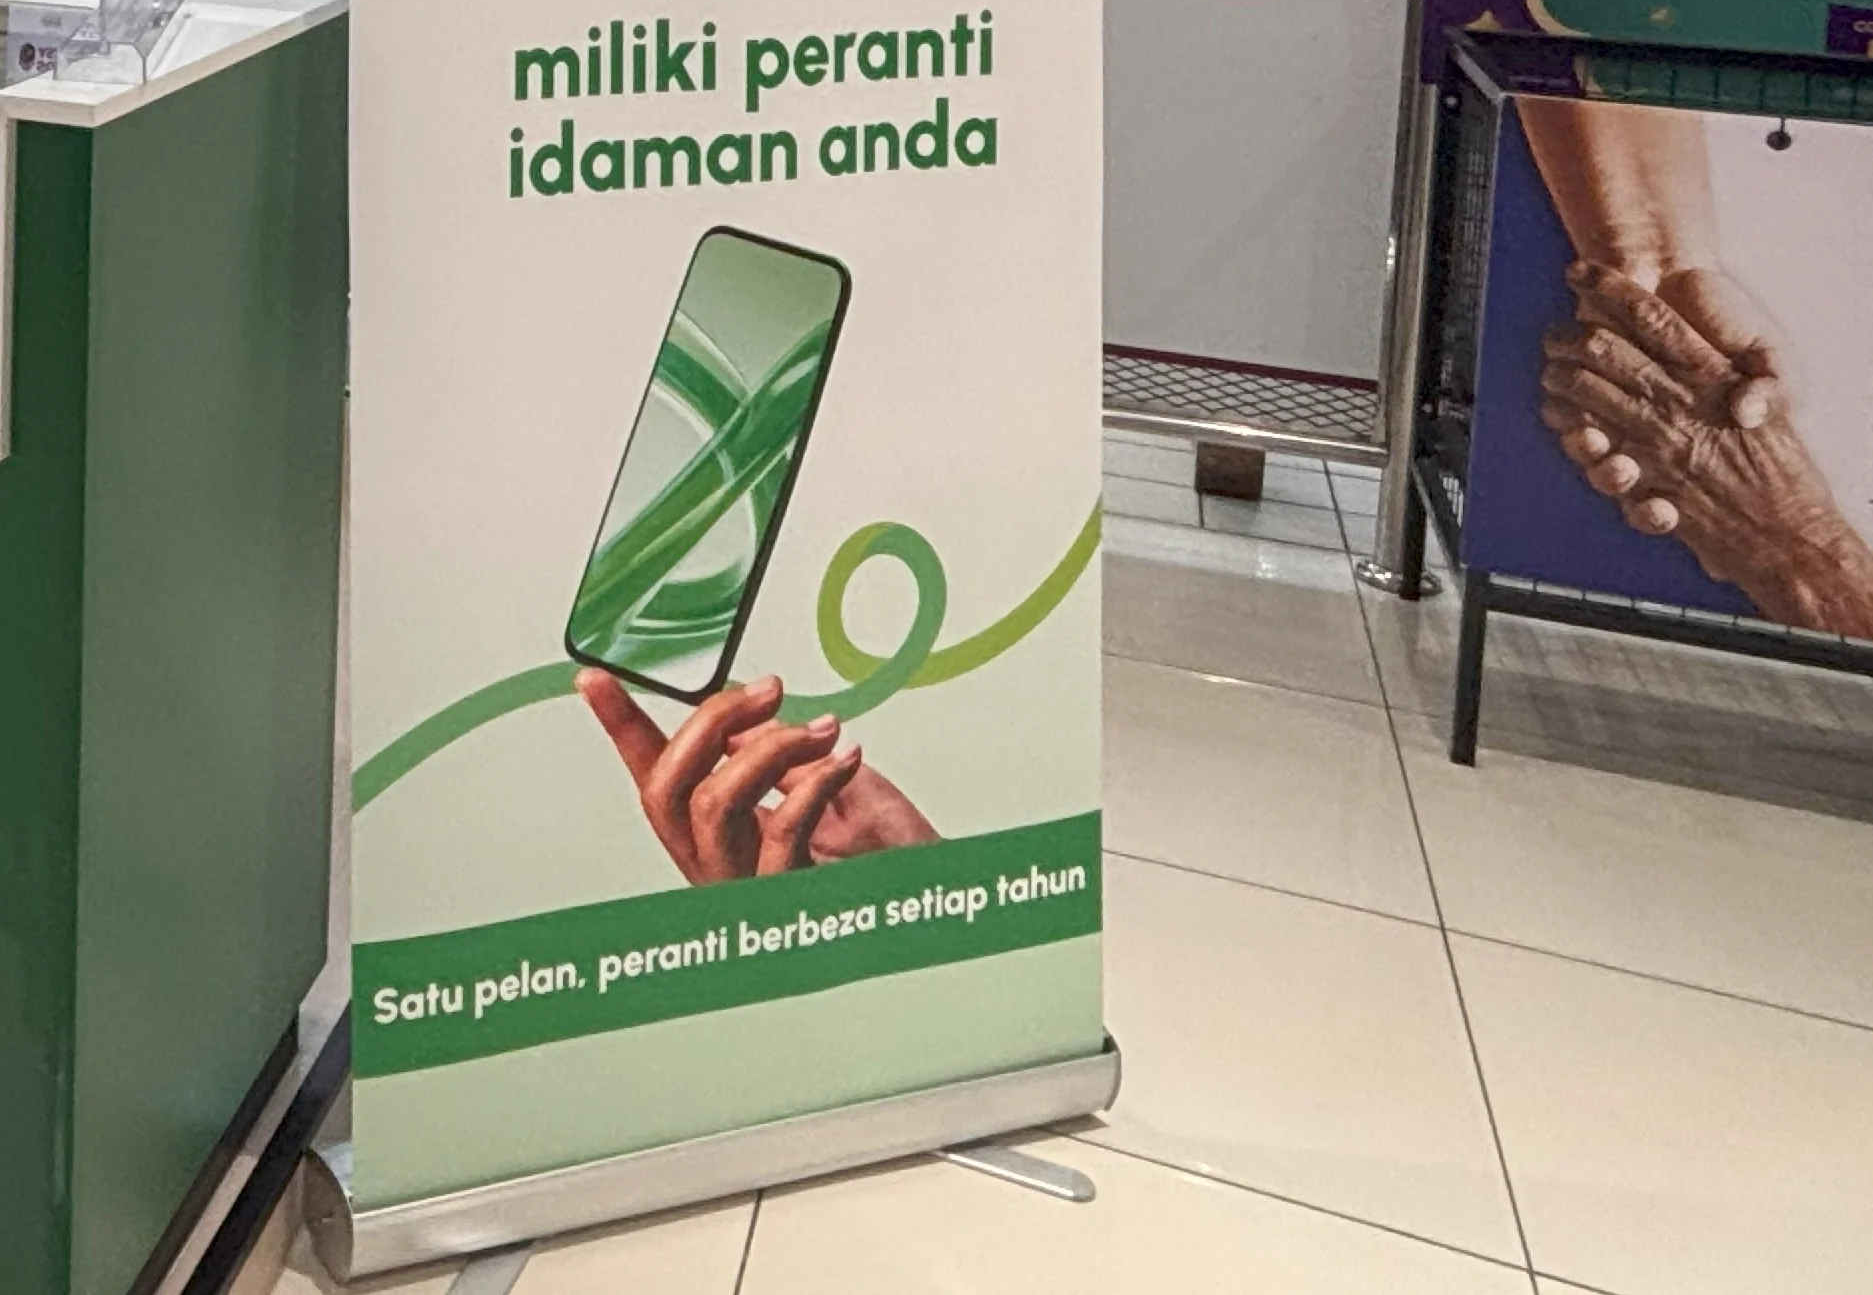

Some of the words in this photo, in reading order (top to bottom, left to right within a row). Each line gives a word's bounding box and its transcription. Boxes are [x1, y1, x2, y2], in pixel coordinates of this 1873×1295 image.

[514, 17, 718, 101] miliki
[745, 9, 995, 113] peranti
[508, 119, 798, 199] idaman
[819, 96, 998, 176] anda
[374, 984, 465, 1026] Satu
[474, 962, 587, 1019] pelan,
[598, 926, 728, 994] peranti
[738, 906, 876, 959] berbeza
[885, 882, 989, 928] setiap
[997, 861, 1086, 907] tahun
